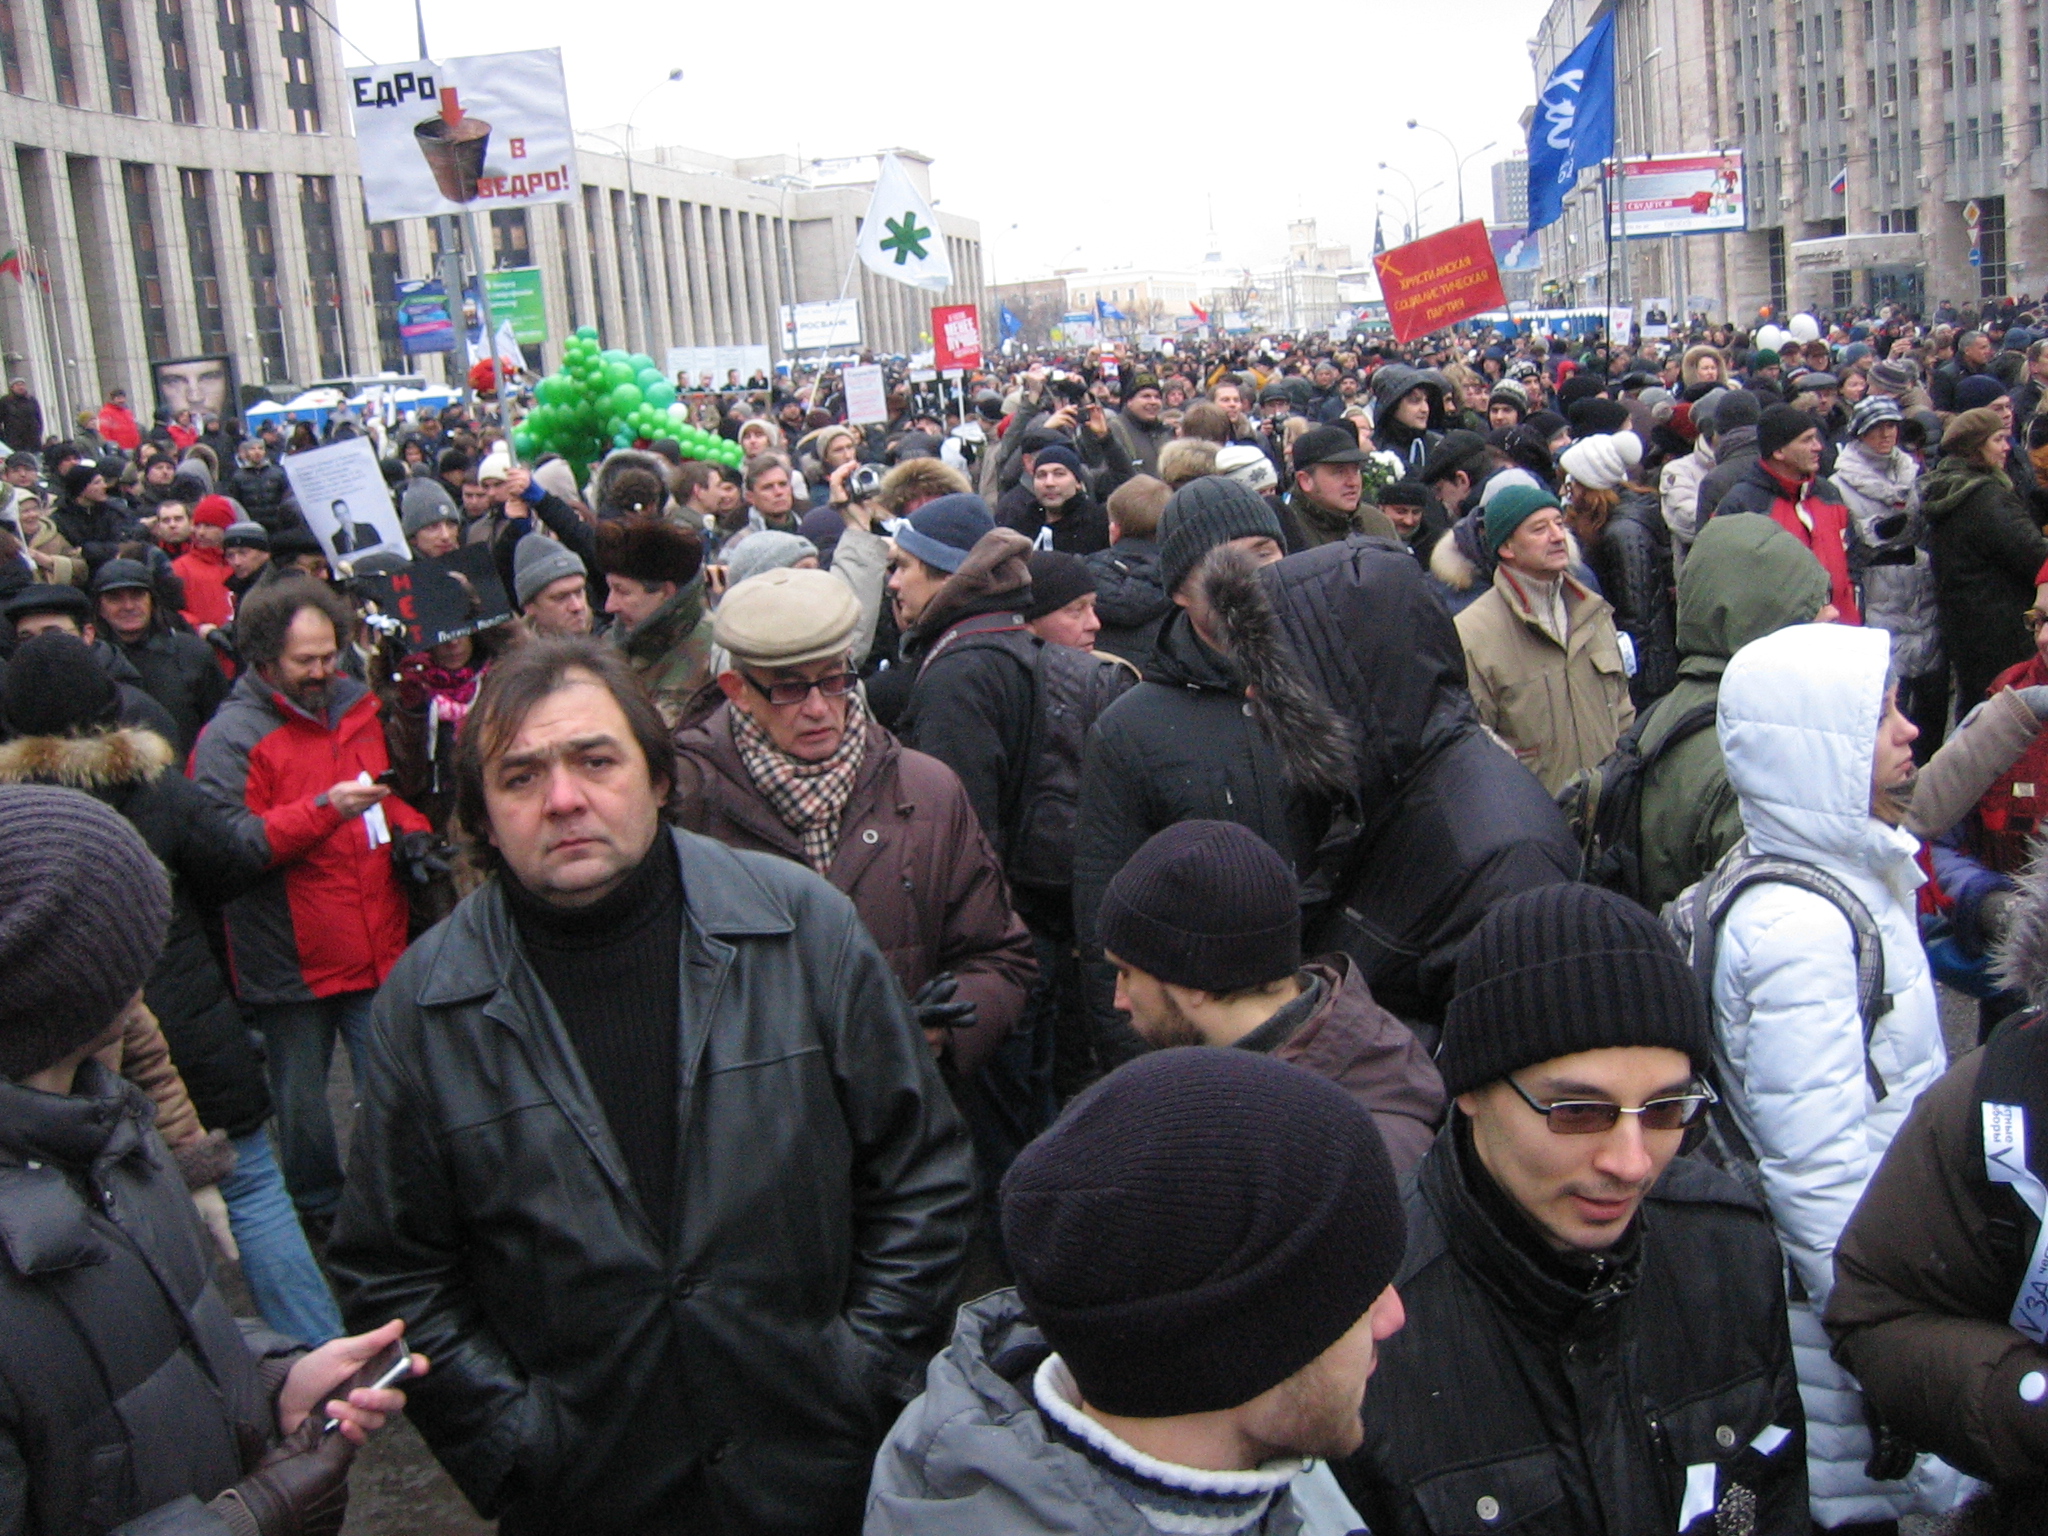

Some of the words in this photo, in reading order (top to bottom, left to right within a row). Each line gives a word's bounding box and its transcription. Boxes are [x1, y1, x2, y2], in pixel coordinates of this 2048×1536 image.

[509, 137, 527, 159] В
[476, 164, 570, 199] ВЕДРО!
[1400, 256, 1472, 290] ХРИСТИАНСКАЯ
[1426, 297, 1465, 320] ПАРТИЯ
